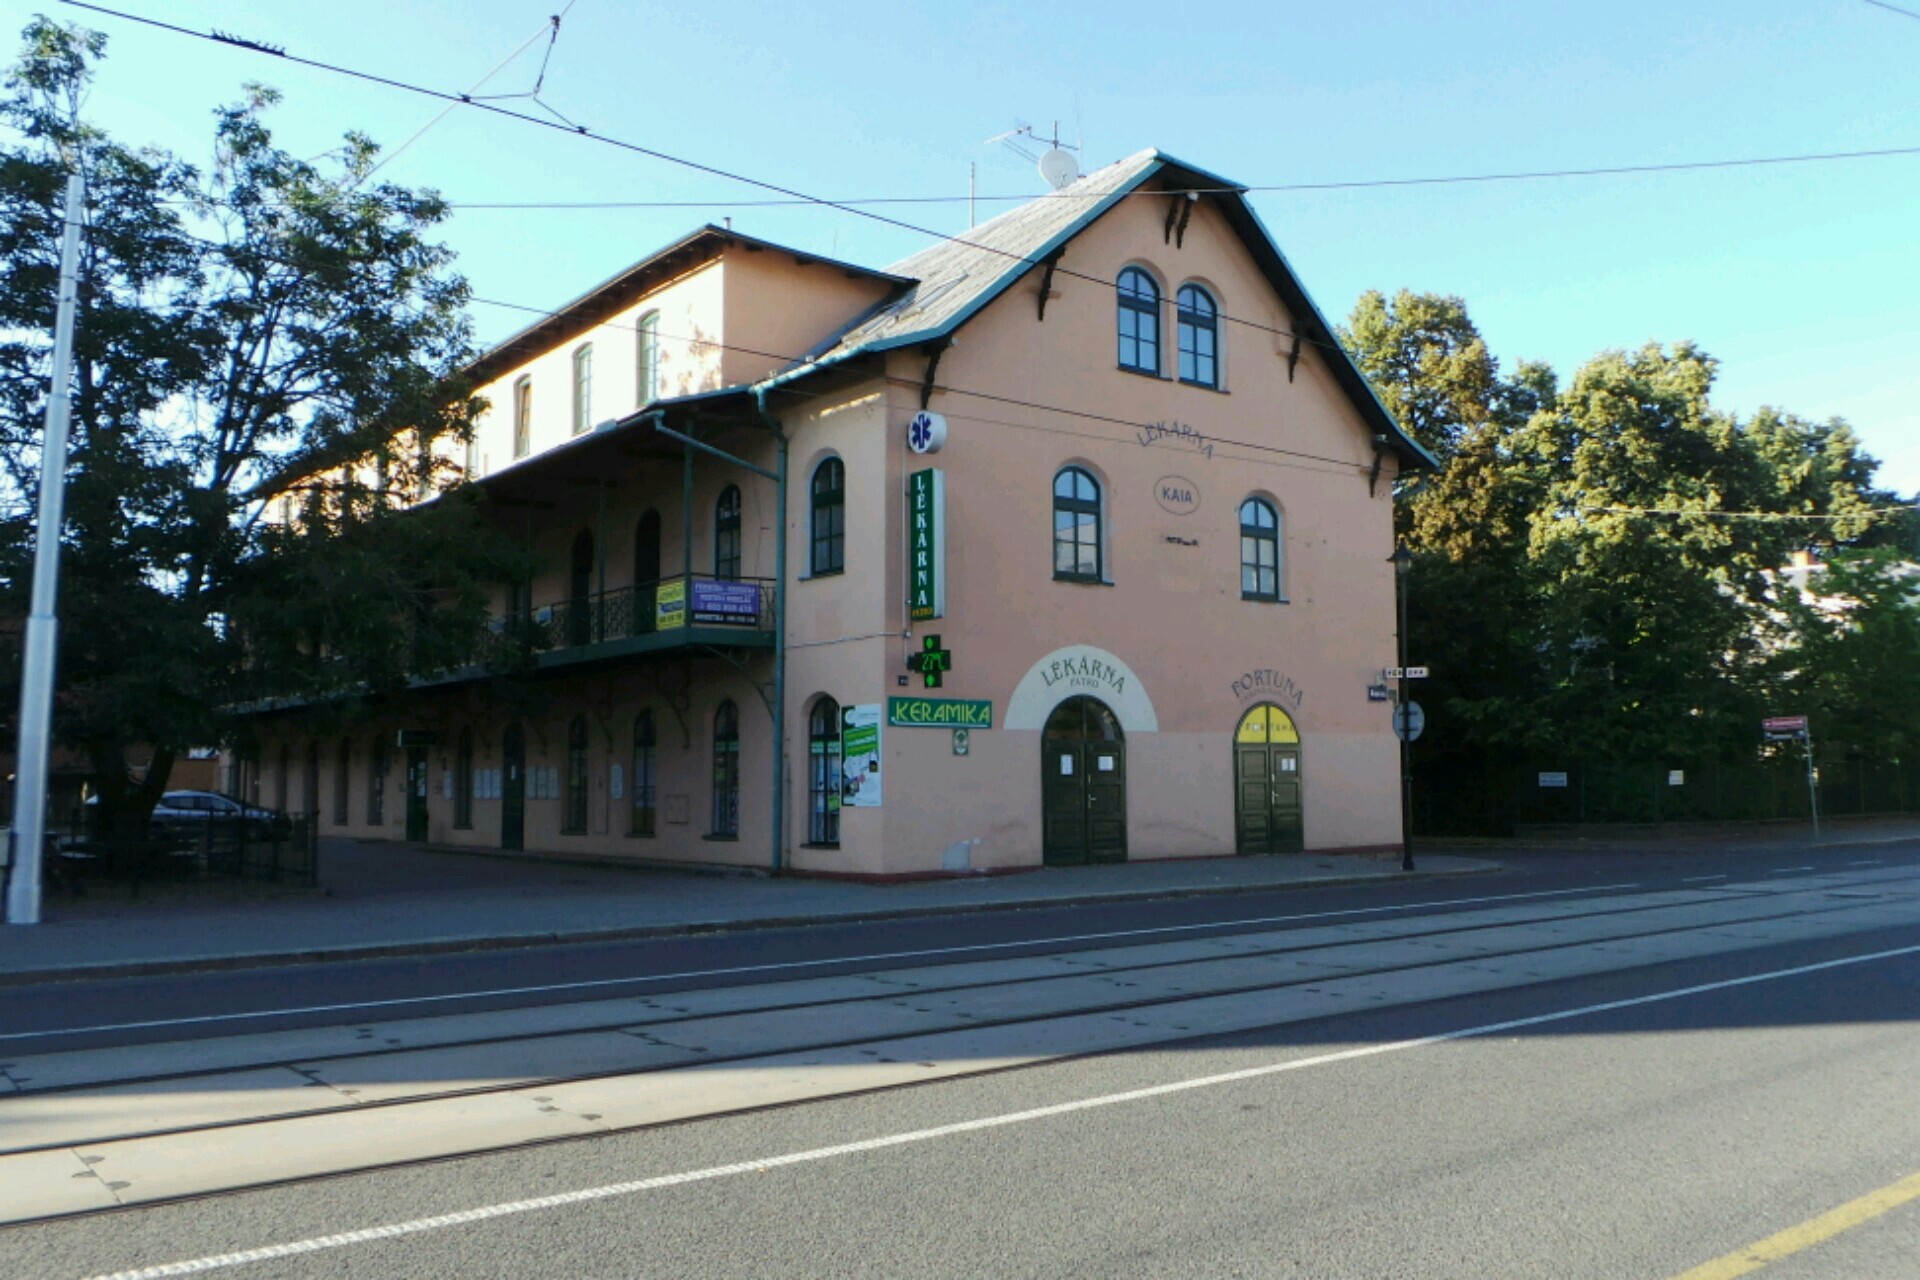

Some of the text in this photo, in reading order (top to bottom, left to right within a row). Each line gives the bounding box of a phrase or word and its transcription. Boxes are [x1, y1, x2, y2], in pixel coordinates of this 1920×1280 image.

[1162, 487, 1192, 503] KAIA
[1070, 677, 1099, 688] PATRO
[1231, 669, 1302, 706] FORTUNA
[895, 701, 990, 723] KERAMIKA
